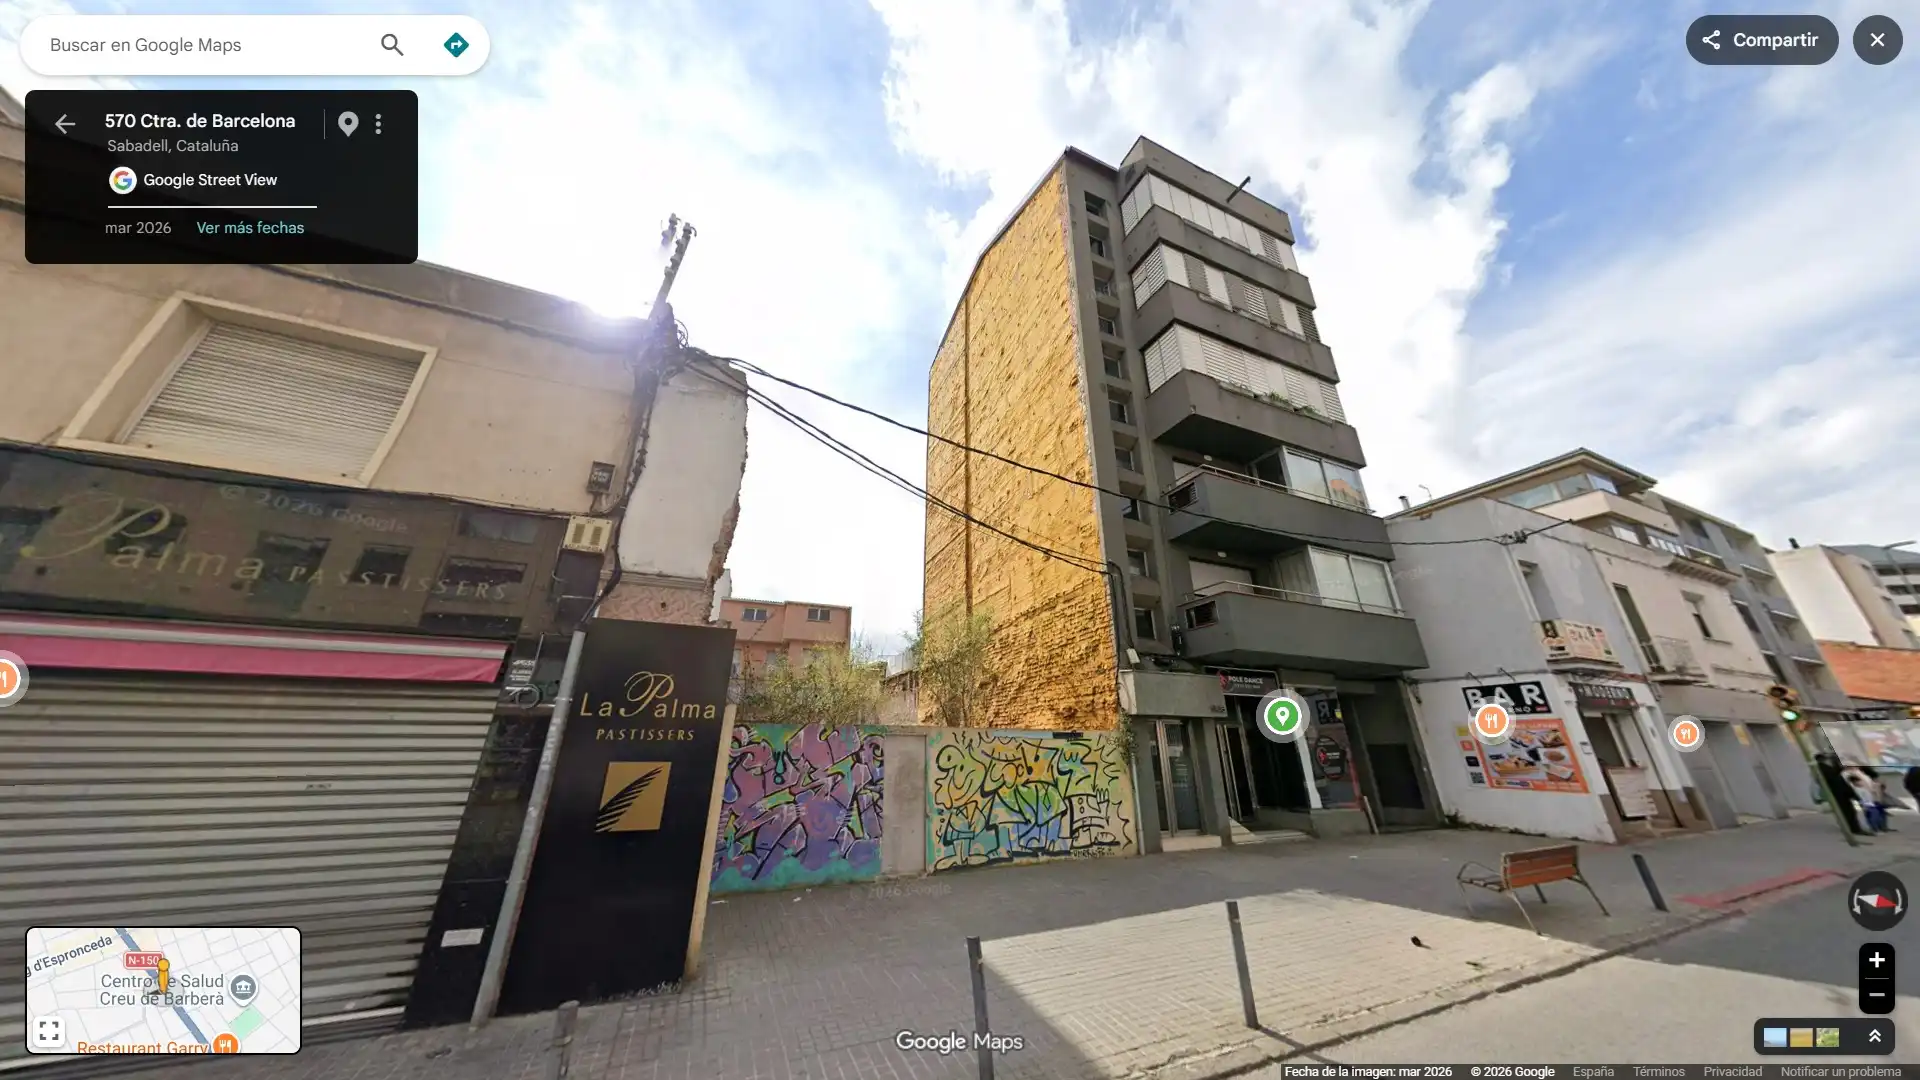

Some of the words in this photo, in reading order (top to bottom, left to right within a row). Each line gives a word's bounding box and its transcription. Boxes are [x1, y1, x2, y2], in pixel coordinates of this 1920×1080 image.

[20, 489, 265, 580] Palma
[580, 692, 612, 717] La
[619, 671, 715, 718] Palma
[1466, 684, 1545, 708] BAR
[596, 728, 695, 741] PASTISSERS
